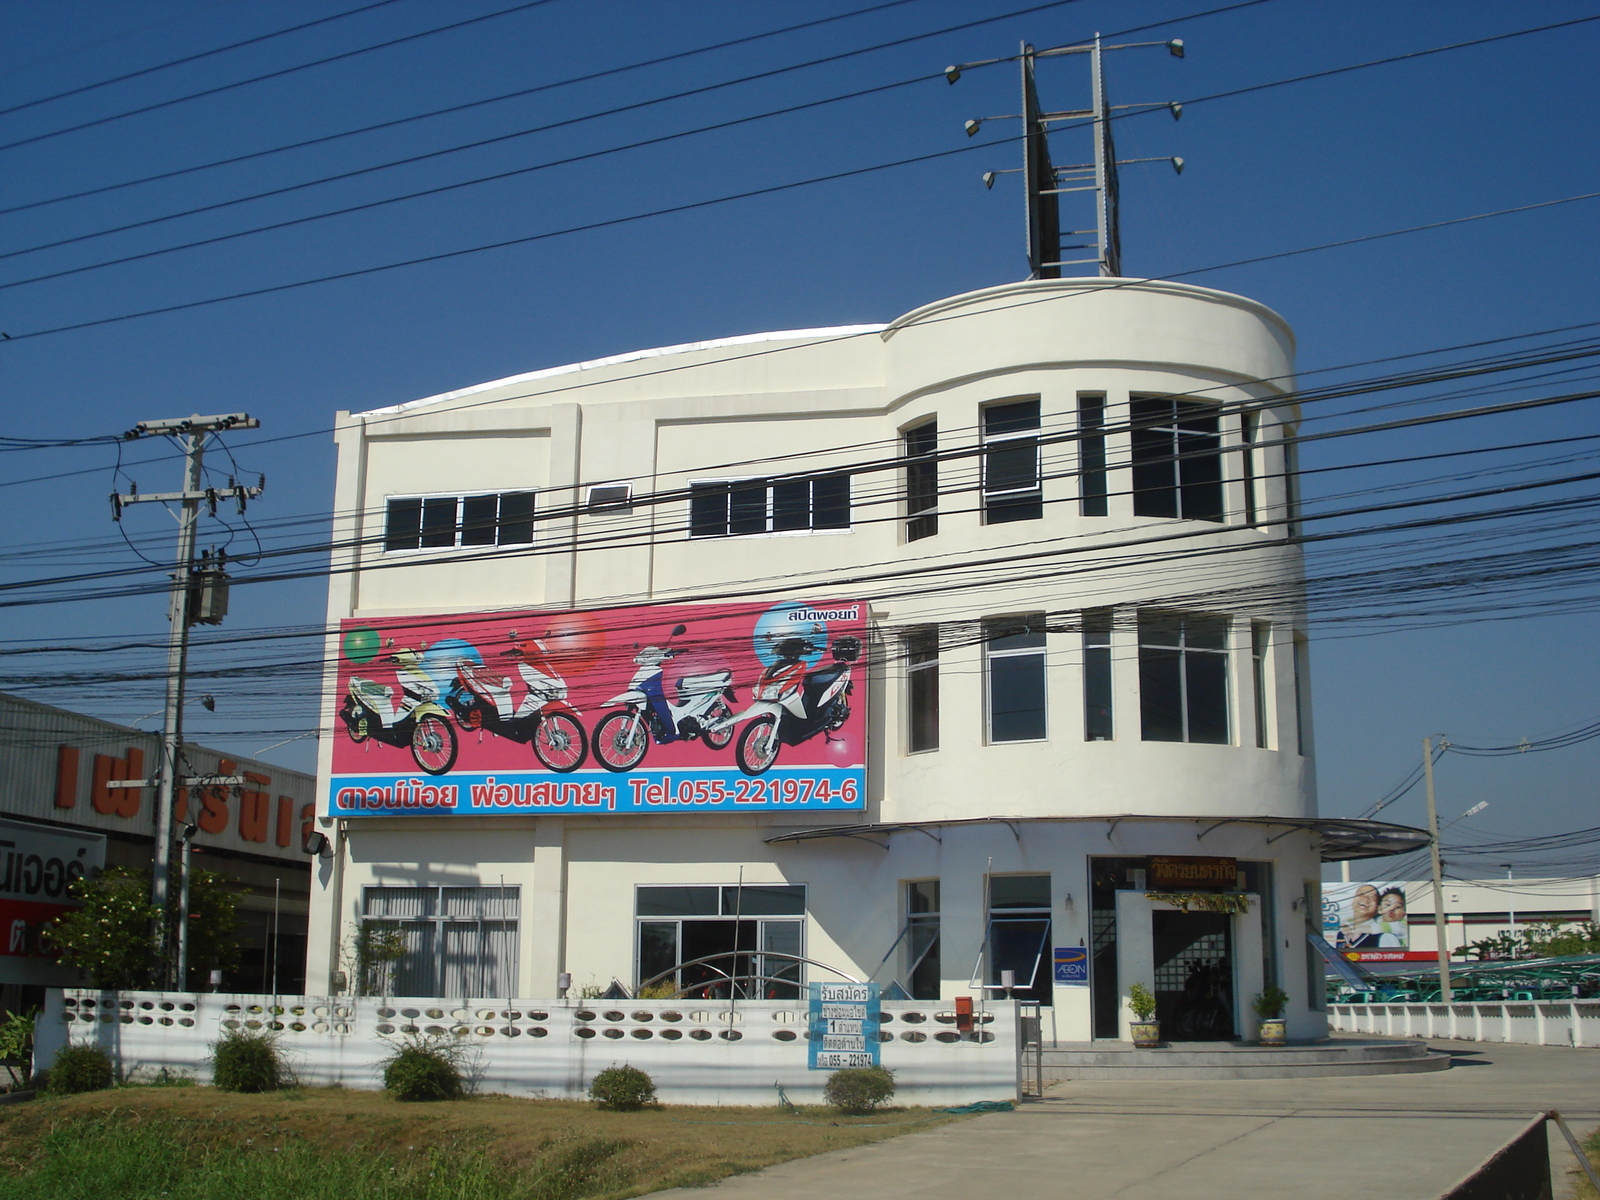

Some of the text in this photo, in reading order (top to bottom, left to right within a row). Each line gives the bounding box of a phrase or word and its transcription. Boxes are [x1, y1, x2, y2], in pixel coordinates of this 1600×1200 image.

[337, 776, 858, 811] ดาวน์น้อย ผ่อนสบายๆ Tel.055-221974-6
[821, 985, 867, 1000] รับสมัคร
[830, 1020, 835, 1032] 1
[829, 1054, 840, 1067] 055
[849, 1054, 872, 1067] 221974
